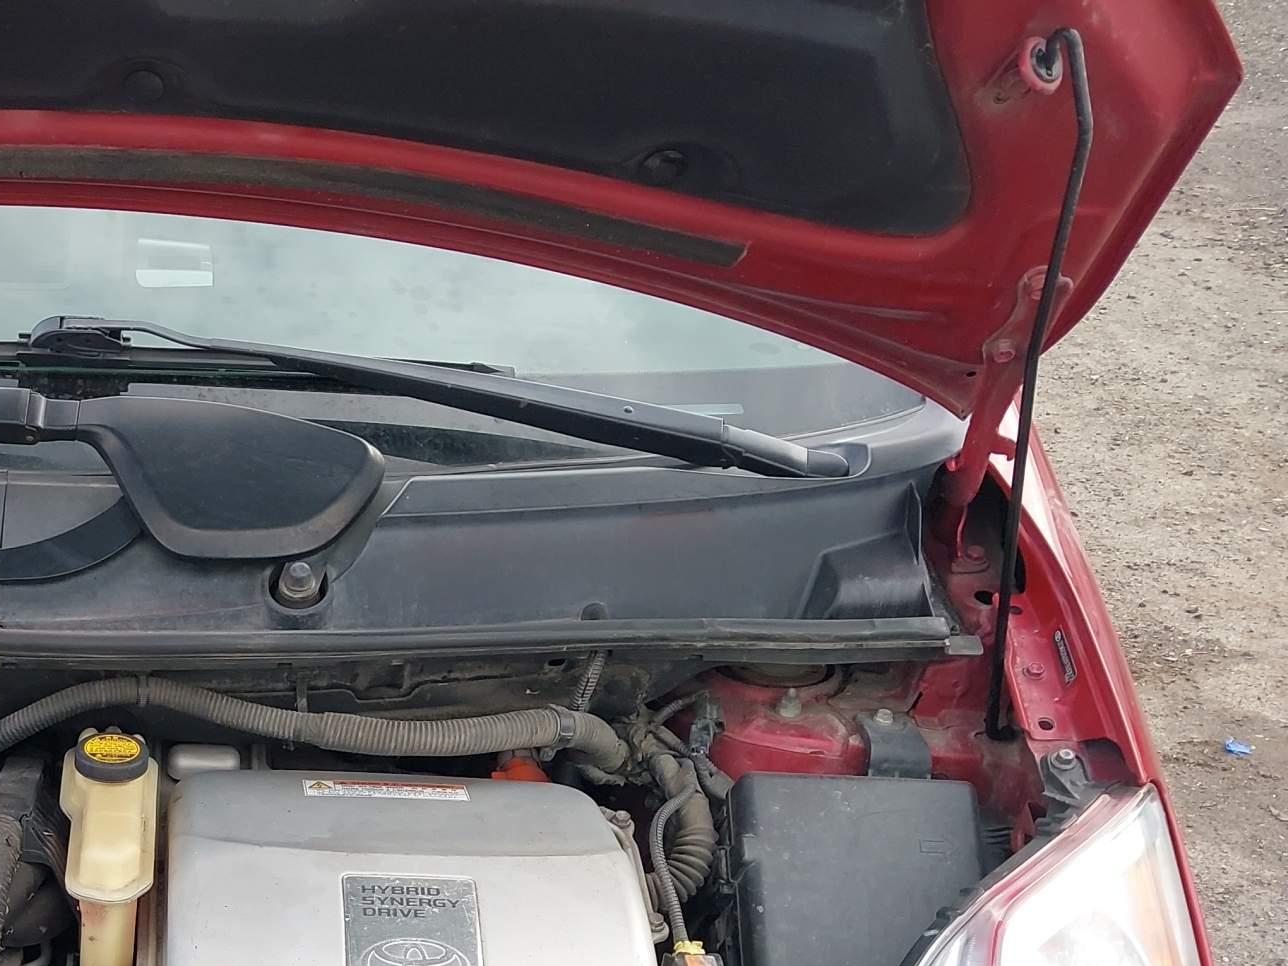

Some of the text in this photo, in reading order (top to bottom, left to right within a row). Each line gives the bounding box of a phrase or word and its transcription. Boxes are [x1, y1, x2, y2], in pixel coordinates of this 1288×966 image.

[361, 885, 441, 896] HYBRID
[361, 896, 461, 908] SYNERGY
[362, 907, 427, 918] DRIVE
